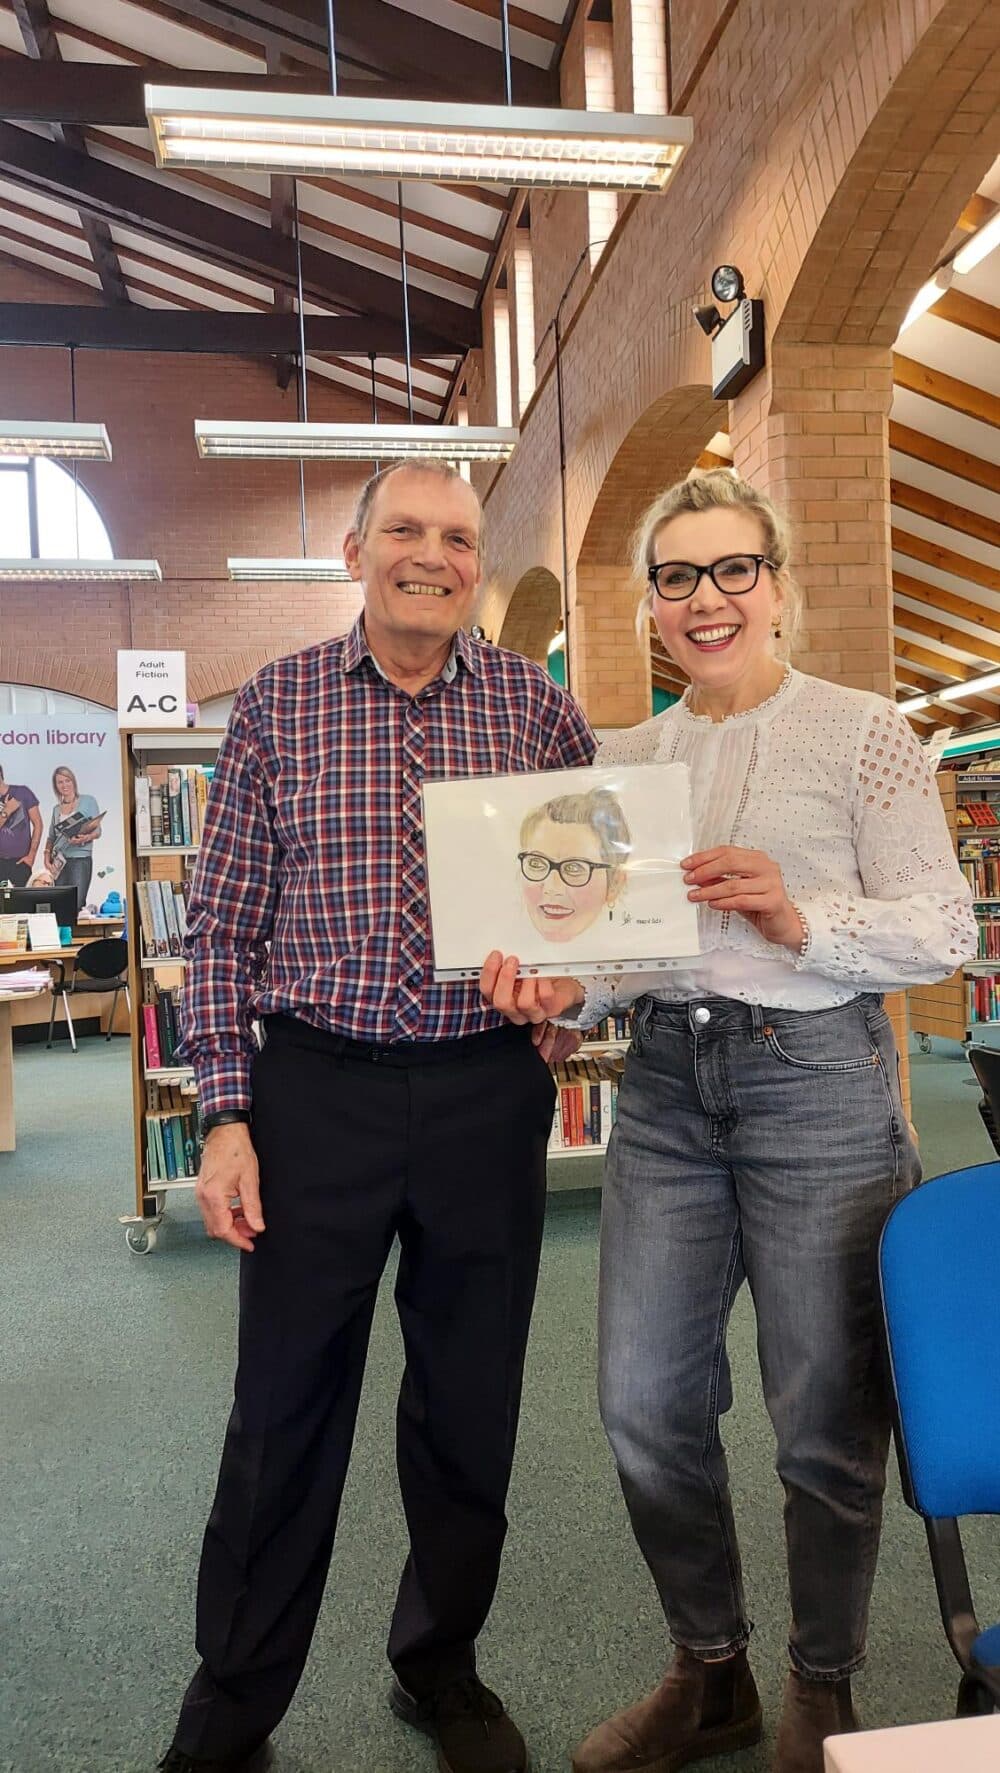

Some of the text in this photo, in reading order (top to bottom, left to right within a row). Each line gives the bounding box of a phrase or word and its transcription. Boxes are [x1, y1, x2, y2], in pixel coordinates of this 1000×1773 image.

[139, 661, 165, 669] Adult
[127, 695, 177, 713] A-C
[0, 729, 106, 747] don library
